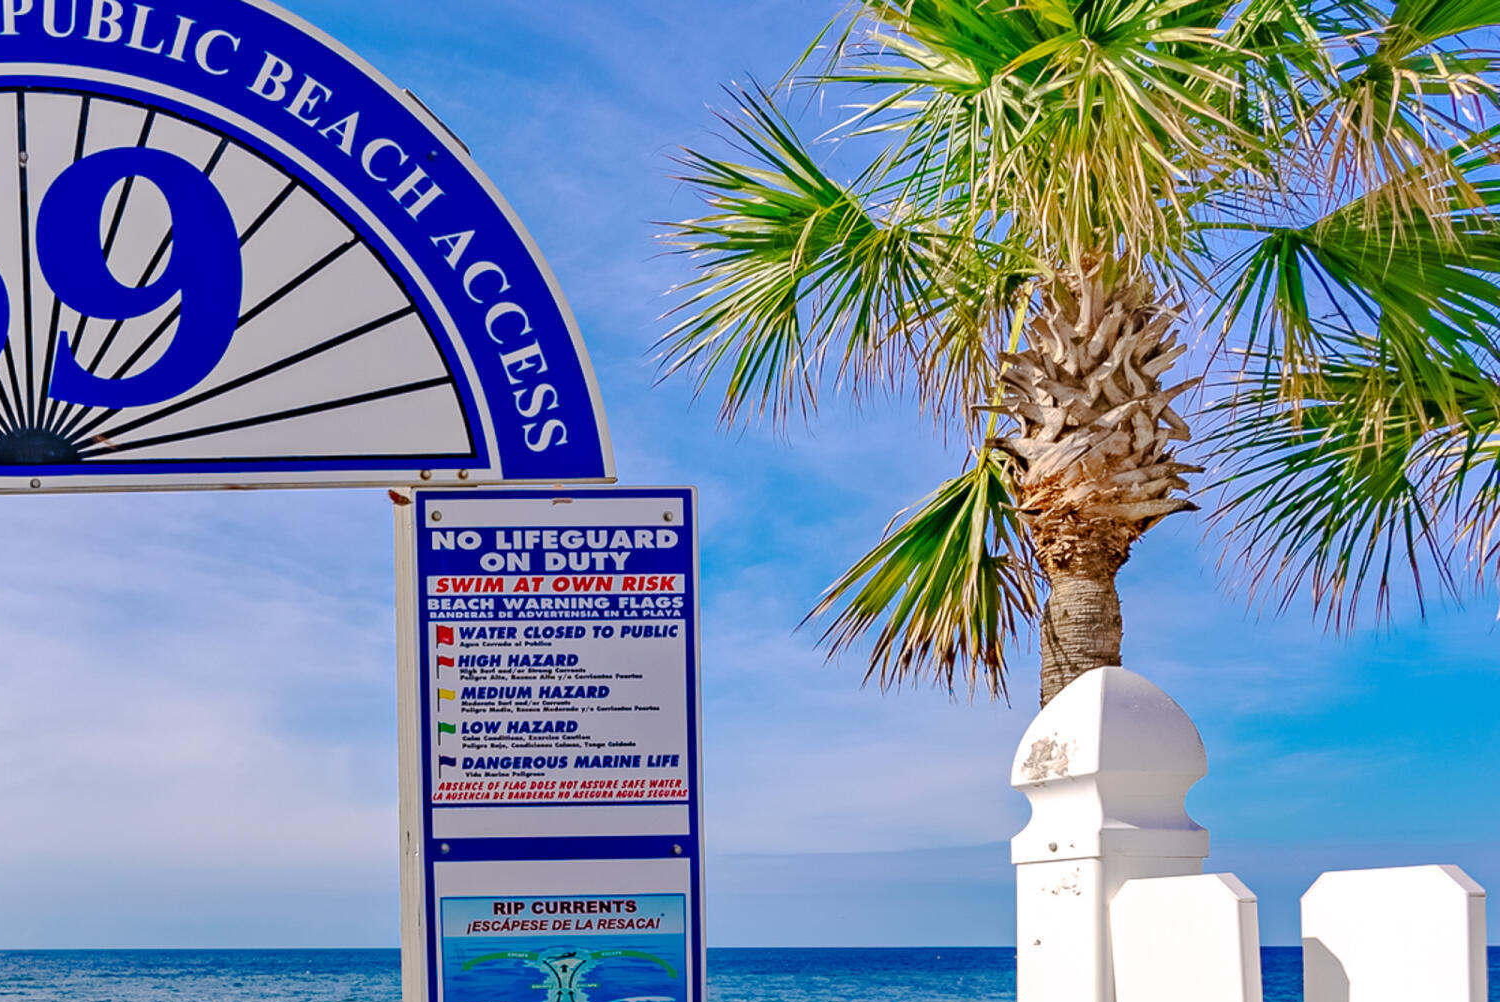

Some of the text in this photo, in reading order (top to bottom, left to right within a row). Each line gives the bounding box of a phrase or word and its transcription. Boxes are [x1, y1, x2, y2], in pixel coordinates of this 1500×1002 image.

[0, 0, 240, 74] PUBLIC
[247, 52, 444, 220] BEACH
[430, 231, 567, 451] ACCESS
[431, 529, 678, 550] NO LIFEGUARD
[480, 551, 630, 572] ON DUTY
[436, 576, 674, 593] SWIM AT OWN RISK
[427, 596, 684, 610] BEACH WARNING FLAGS
[518, 610, 599, 618] ADVERTENSIA
[643, 609, 681, 617] PLAYA
[459, 625, 678, 639] WATER CLOSED TO PUBLIC
[458, 654, 578, 667] HIGH HAZARD
[460, 685, 610, 699] MEDIUM HAZARD
[461, 720, 578, 734] LOW HAZARD
[462, 754, 679, 769] DANGEROUS MARINE LIFE
[439, 779, 682, 791] ABSENCE OF FLAG DOES NOT ASSURE SAFE WATER
[446, 792, 490, 800] AUSENCIA
[508, 791, 554, 799] BANDERAS
[573, 791, 613, 799] ASEGURA
[616, 790, 644, 798] AGUAS
[647, 789, 688, 797] SEGURAS
[493, 900, 636, 915] RIP CURRENTS
[552, 919, 572, 930] DE
[575, 919, 593, 930] LA
[596, 917, 661, 930] RESACA!
